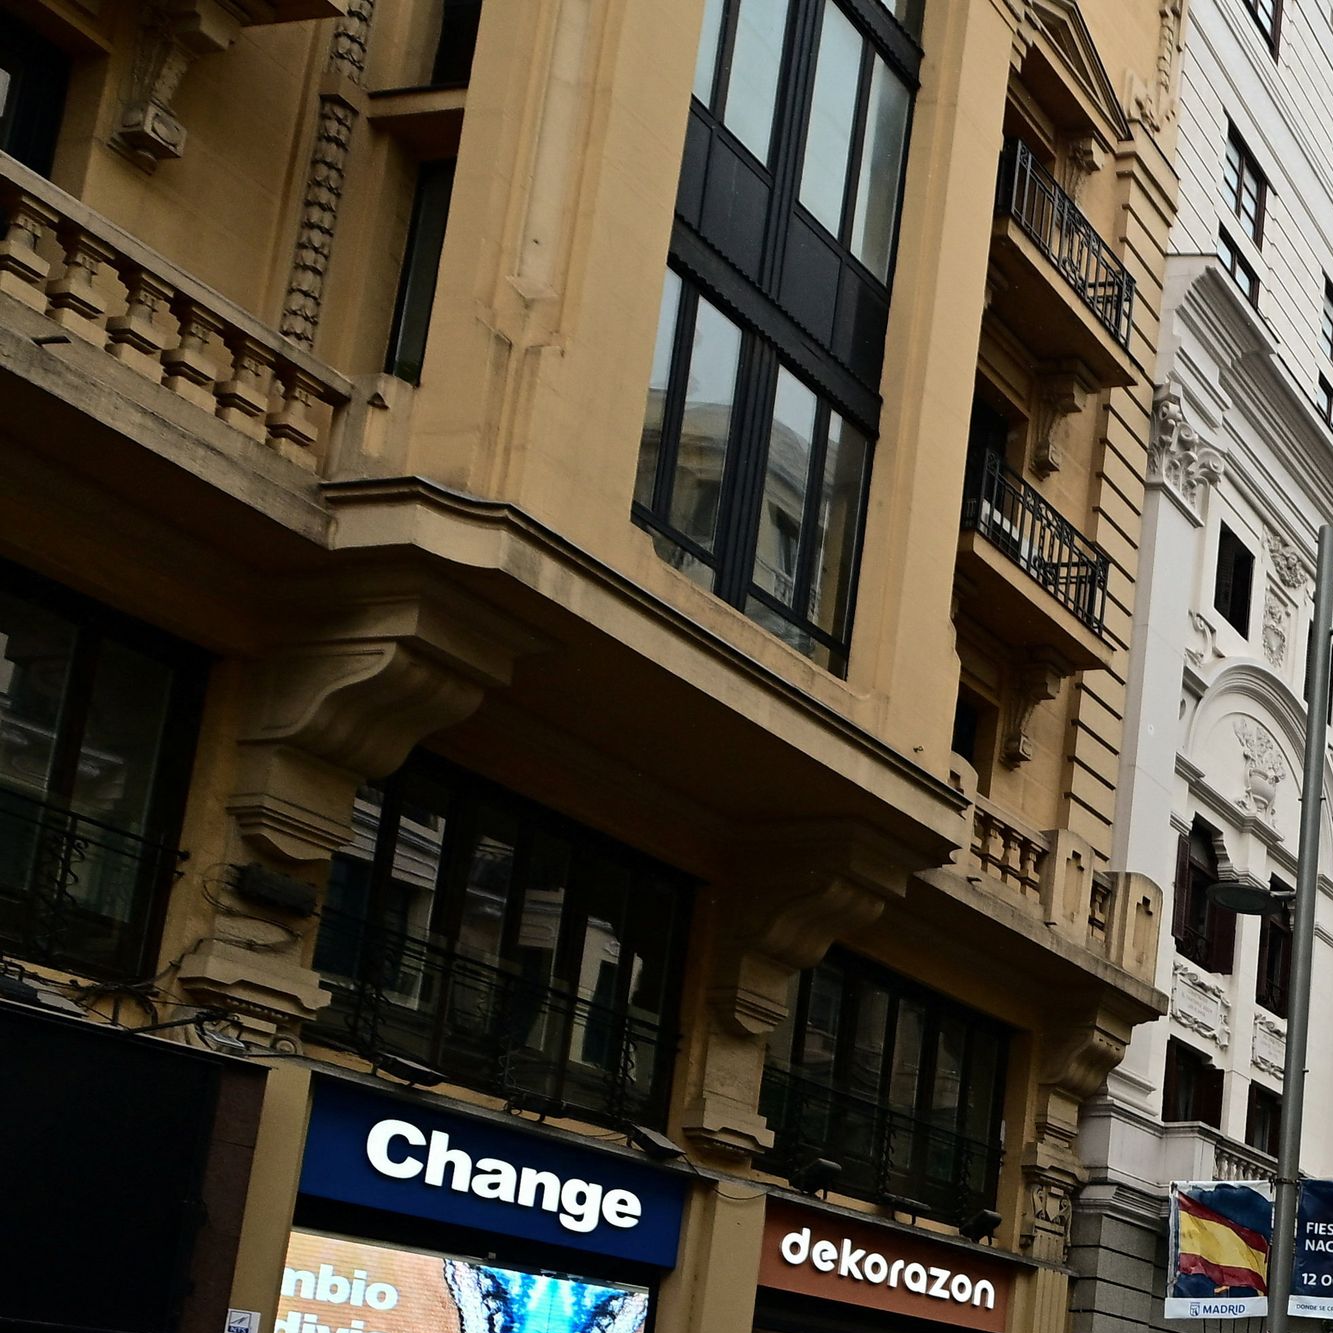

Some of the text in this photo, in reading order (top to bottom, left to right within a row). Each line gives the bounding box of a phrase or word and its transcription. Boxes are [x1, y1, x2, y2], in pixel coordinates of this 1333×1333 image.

[366, 1118, 642, 1233] Change
[780, 1227, 996, 1310] dekorazon
[1301, 1272, 1316, 1286] 12
[1202, 1304, 1246, 1317] MADRID
